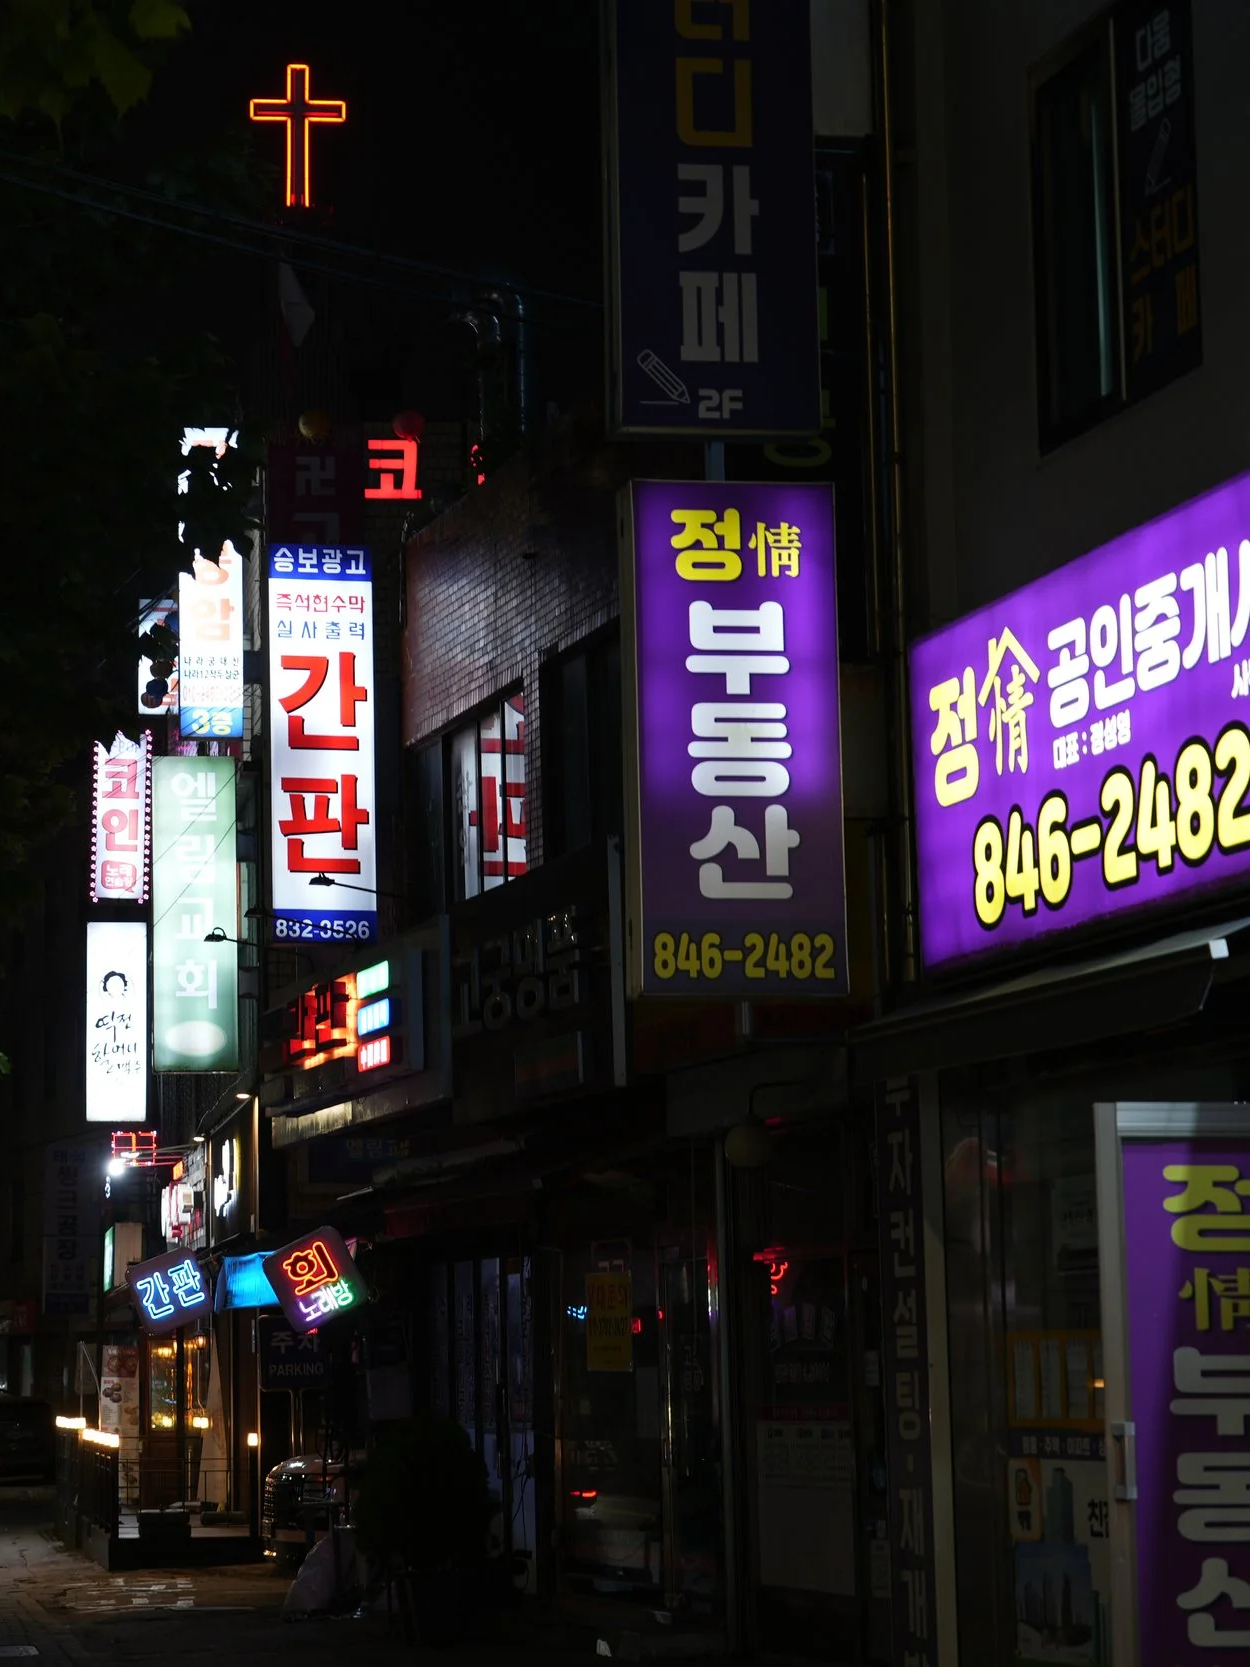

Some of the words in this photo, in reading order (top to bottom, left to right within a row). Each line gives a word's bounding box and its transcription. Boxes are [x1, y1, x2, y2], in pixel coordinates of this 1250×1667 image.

[697, 388, 744, 420] 2F
[273, 547, 367, 576] 승보광고
[277, 651, 370, 875] 간판
[684, 600, 802, 900] 부동산
[101, 758, 140, 852] 코인
[974, 722, 1250, 928] 846-2482
[171, 771, 218, 1010] 엘림교회
[275, 919, 371, 940] 832-3526
[653, 931, 837, 980] 846-2482
[136, 1259, 206, 1320] 간판
[282, 1241, 339, 1296] 회
[298, 1279, 354, 1322] 노래방
[268, 1362, 325, 1379] PARKING
